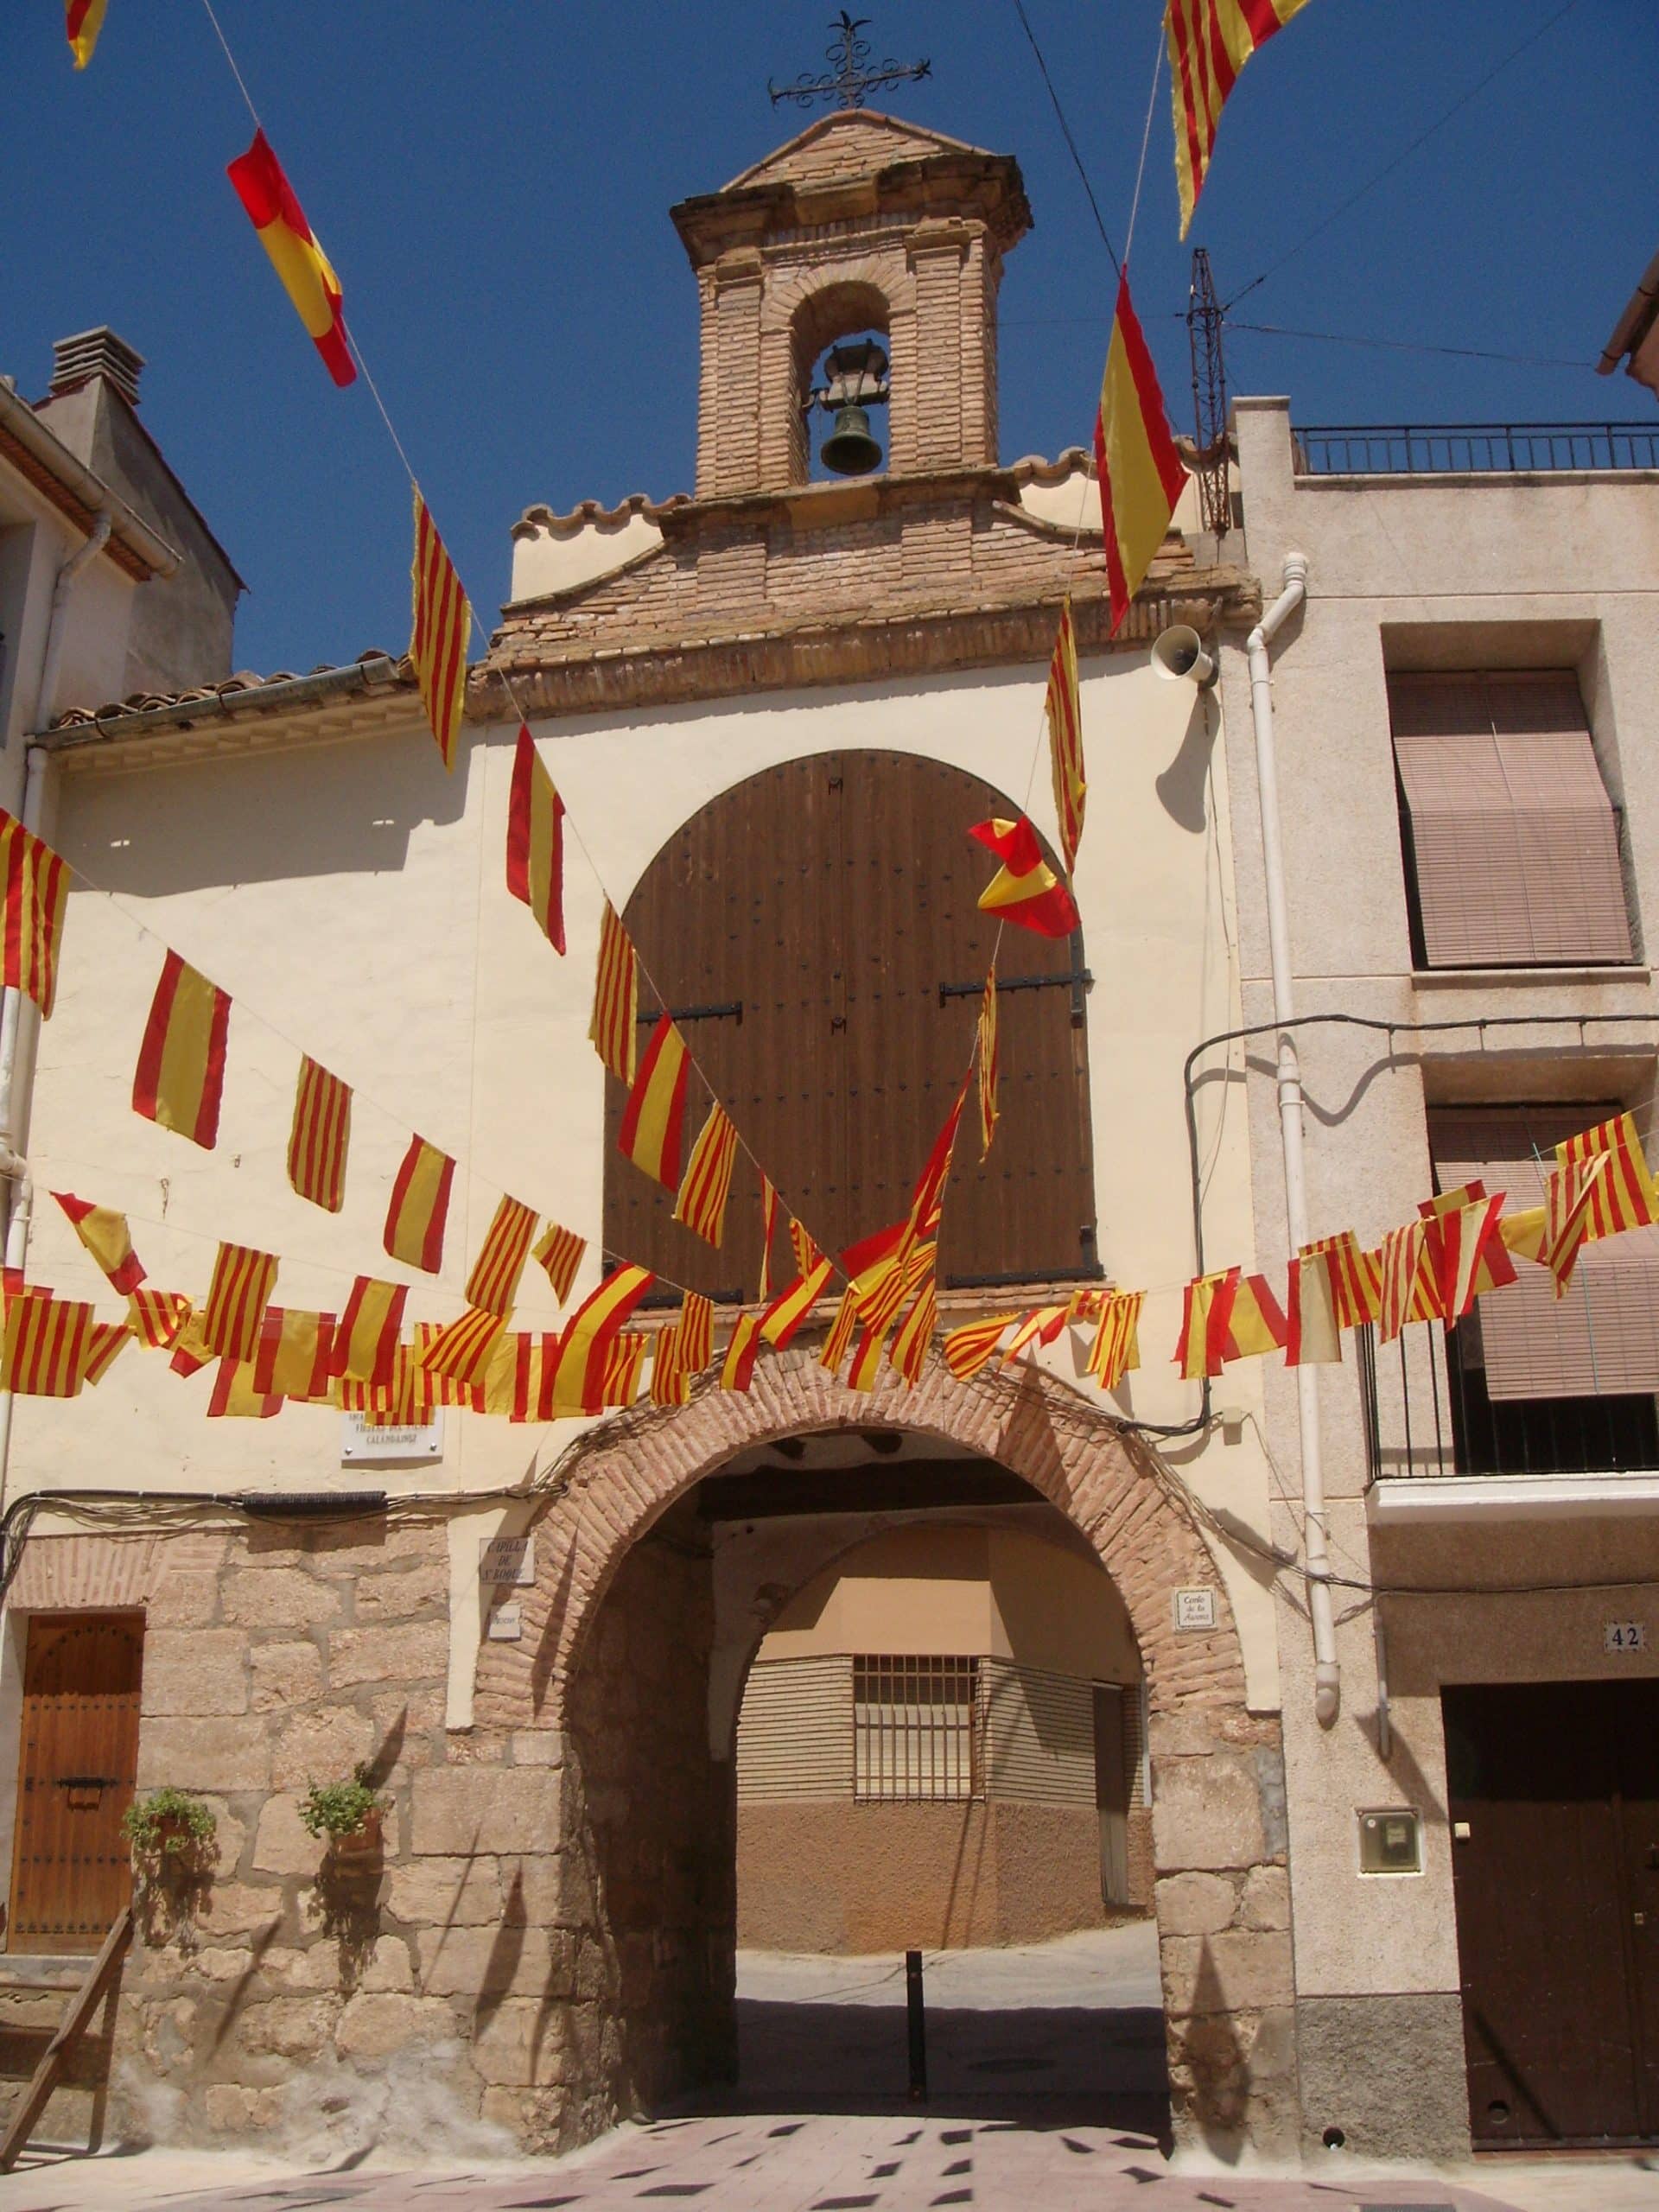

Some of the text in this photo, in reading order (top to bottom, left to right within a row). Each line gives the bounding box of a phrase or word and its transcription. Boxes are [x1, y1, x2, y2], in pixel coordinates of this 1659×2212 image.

[487, 1541, 529, 1553] CAPILLA
[498, 1555, 512, 1566] DE
[493, 1568, 524, 1580] ROQUE
[1612, 1628, 1638, 1645] 42
